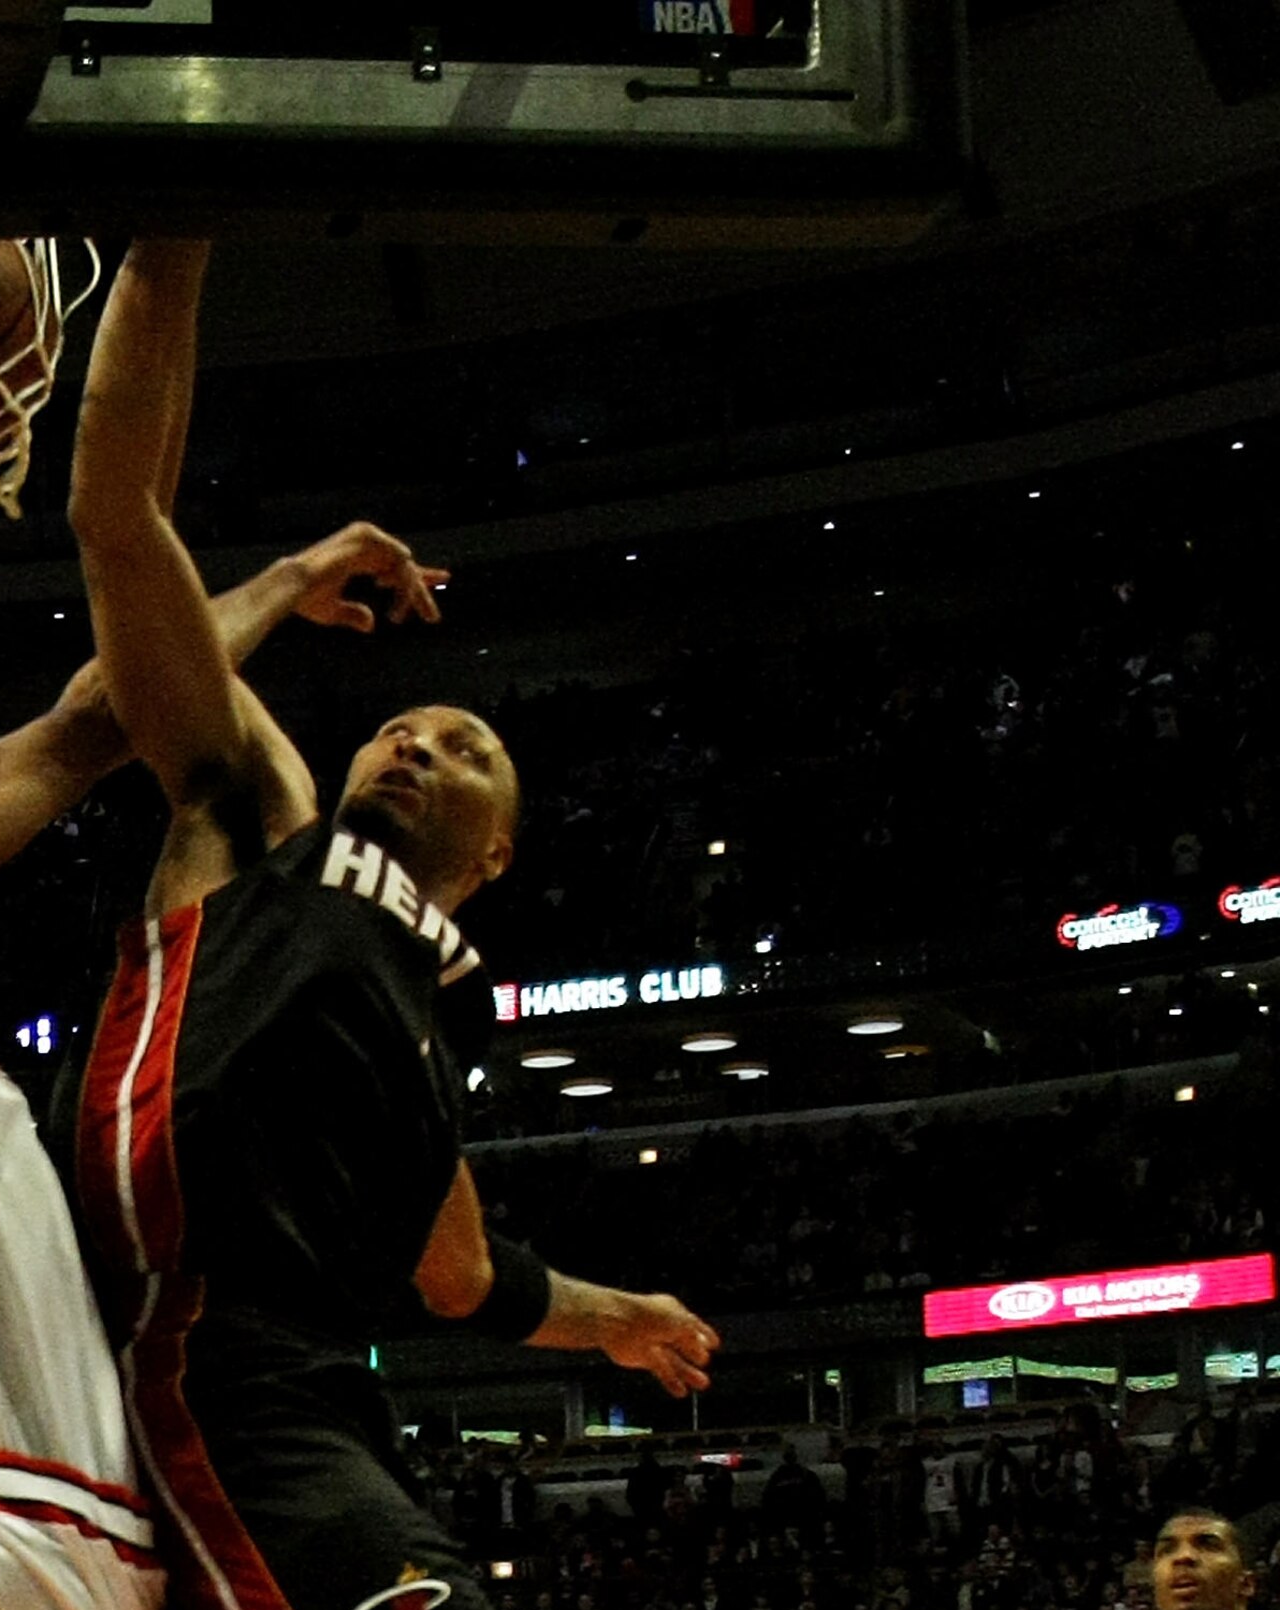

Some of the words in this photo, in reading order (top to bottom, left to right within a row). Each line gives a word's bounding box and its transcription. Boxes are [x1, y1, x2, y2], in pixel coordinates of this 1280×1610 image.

[652, 1, 717, 34] NBA
[521, 976, 628, 1017] HARRIS
[639, 967, 722, 1004] CLUB
[1062, 1285, 1102, 1305] KIA
[1105, 1275, 1200, 1302] MOTORS
